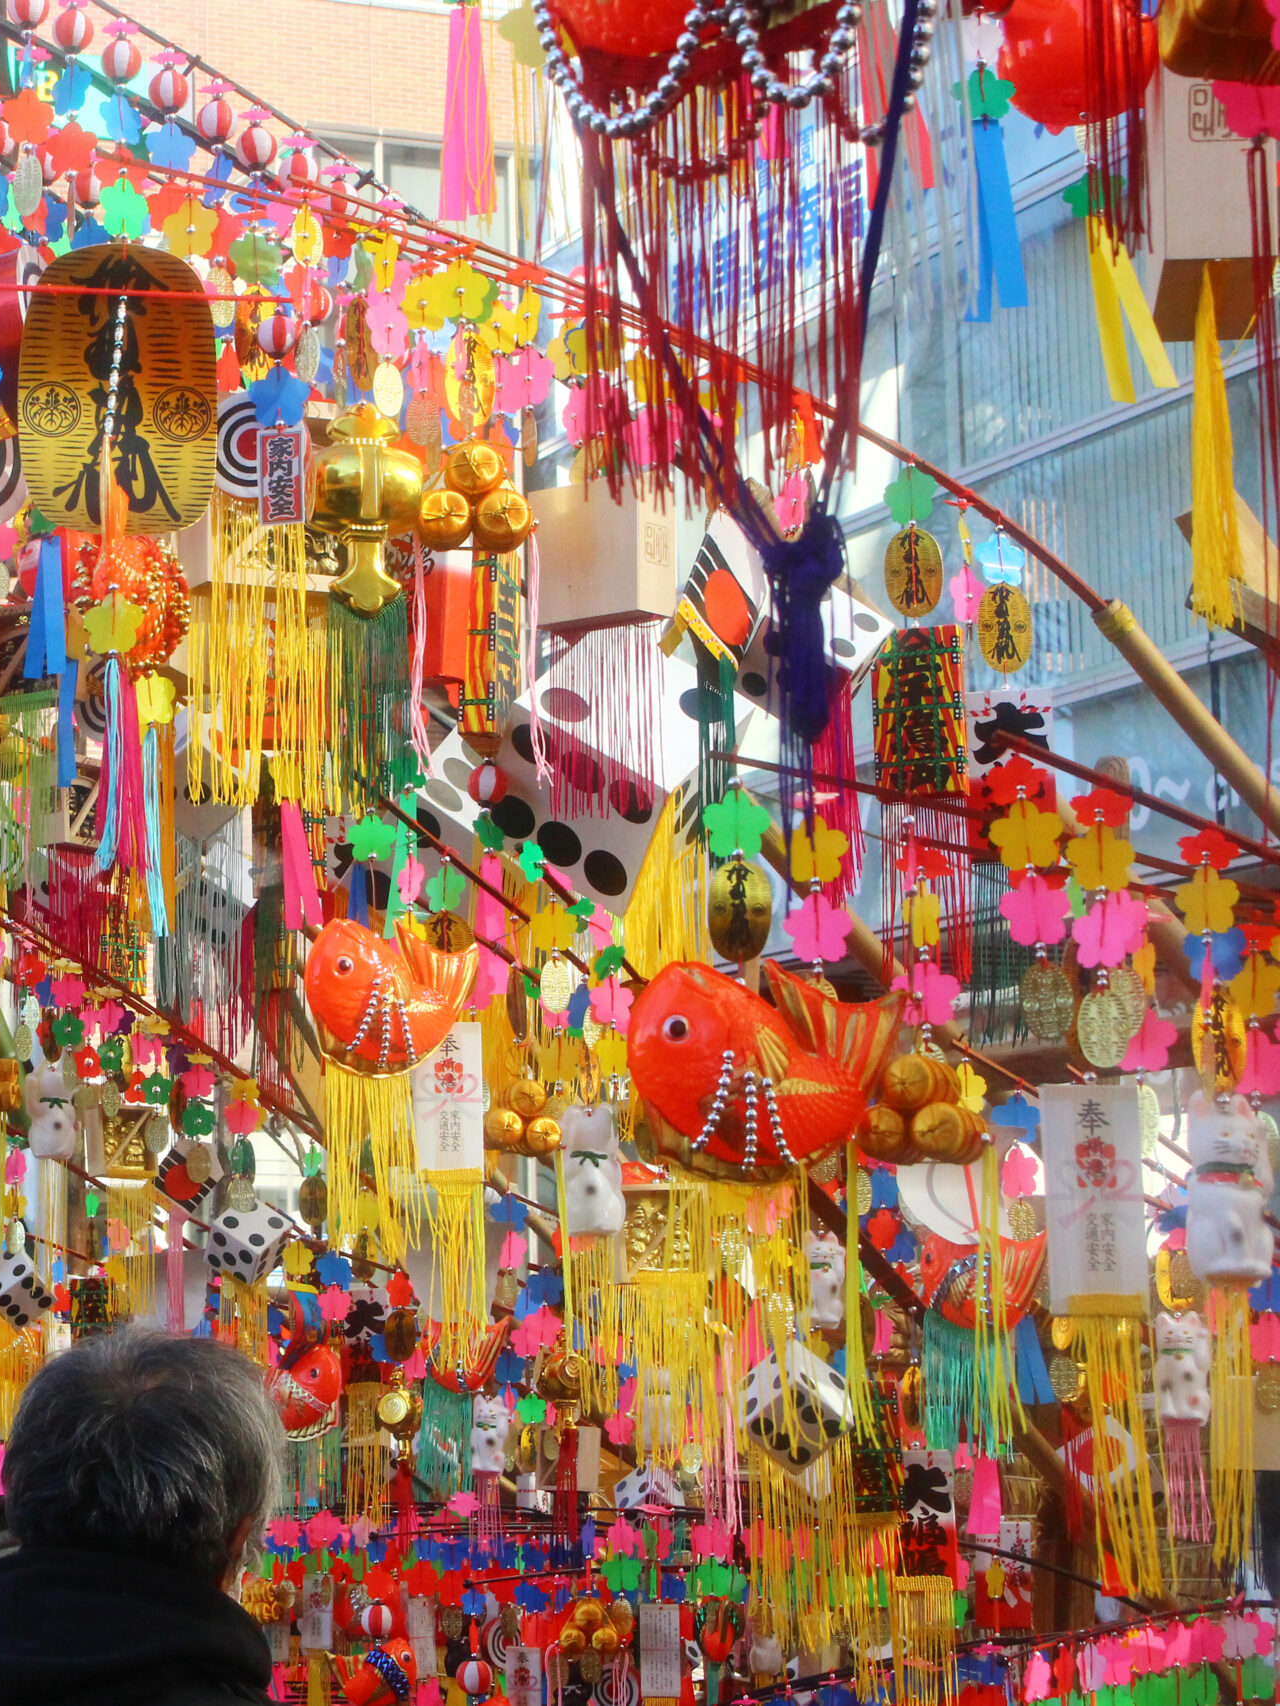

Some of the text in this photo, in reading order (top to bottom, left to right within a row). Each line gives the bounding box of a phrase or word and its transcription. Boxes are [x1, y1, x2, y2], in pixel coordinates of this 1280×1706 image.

[267, 436, 297, 519] 家内安全
[439, 1109, 450, 1152] 交通安全
[450, 1109, 461, 1152] 家内安全
